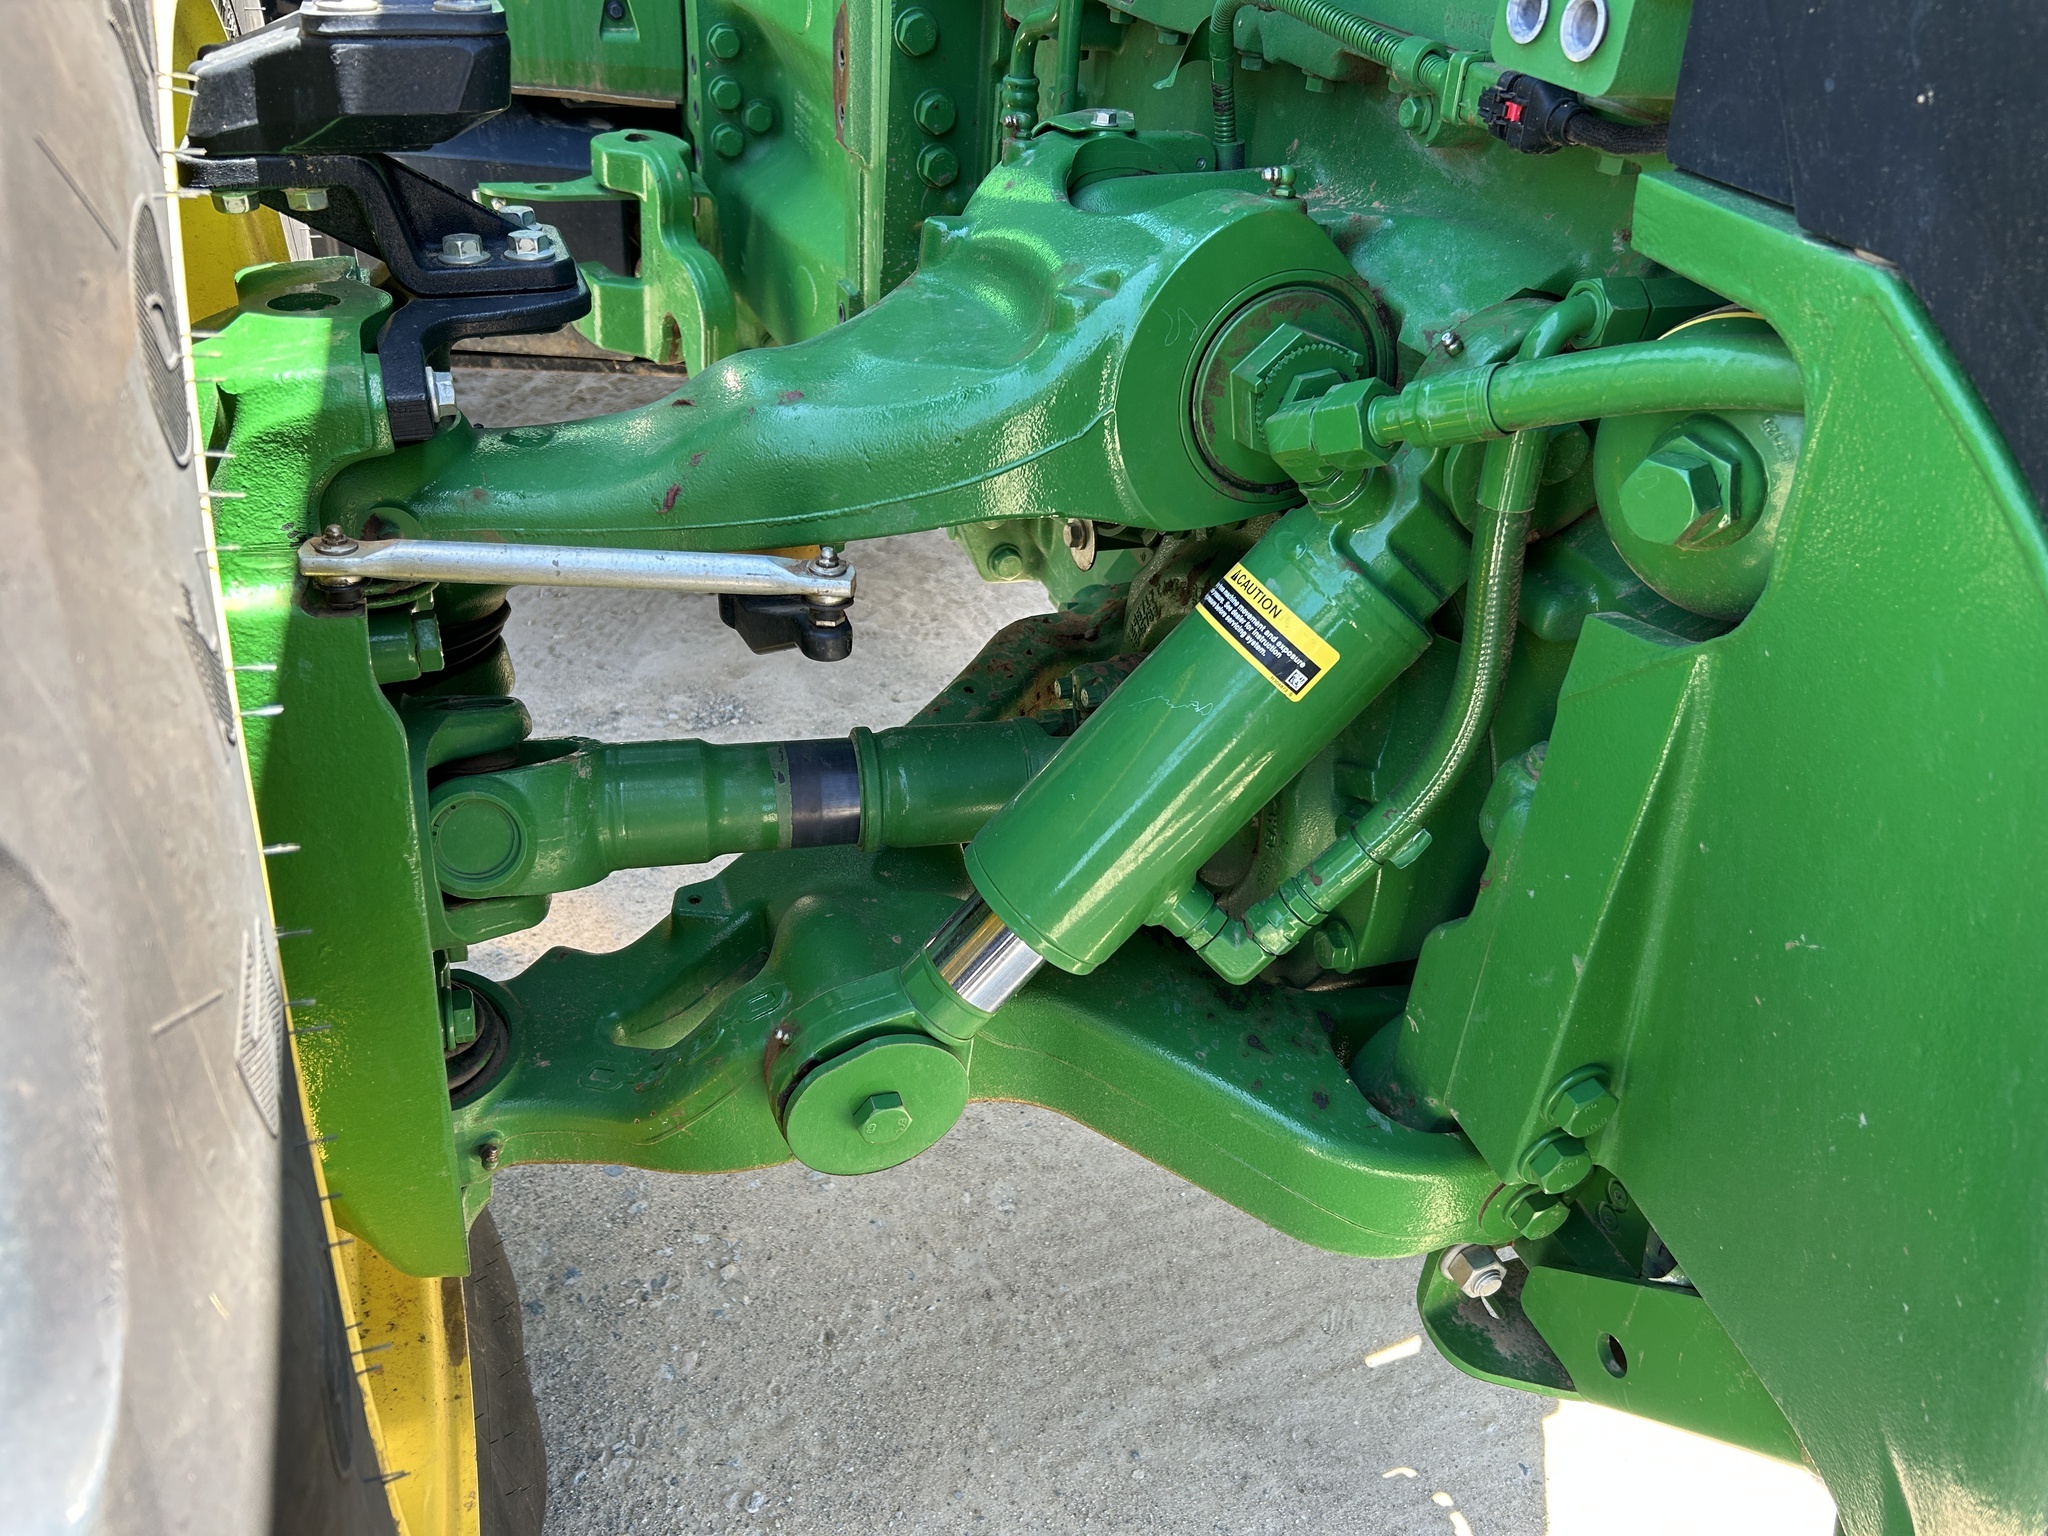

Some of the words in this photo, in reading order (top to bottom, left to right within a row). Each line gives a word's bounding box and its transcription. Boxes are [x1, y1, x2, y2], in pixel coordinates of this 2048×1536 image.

[1236, 574, 1283, 619] CAUTION
[1224, 614, 1248, 638] servicing
[1244, 634, 1267, 657] system.
[1230, 609, 1247, 624] dealer
[1244, 621, 1255, 631] for
[1237, 604, 1267, 632] movement
[1263, 629, 1279, 643] and
[1276, 640, 1306, 668] exposure
